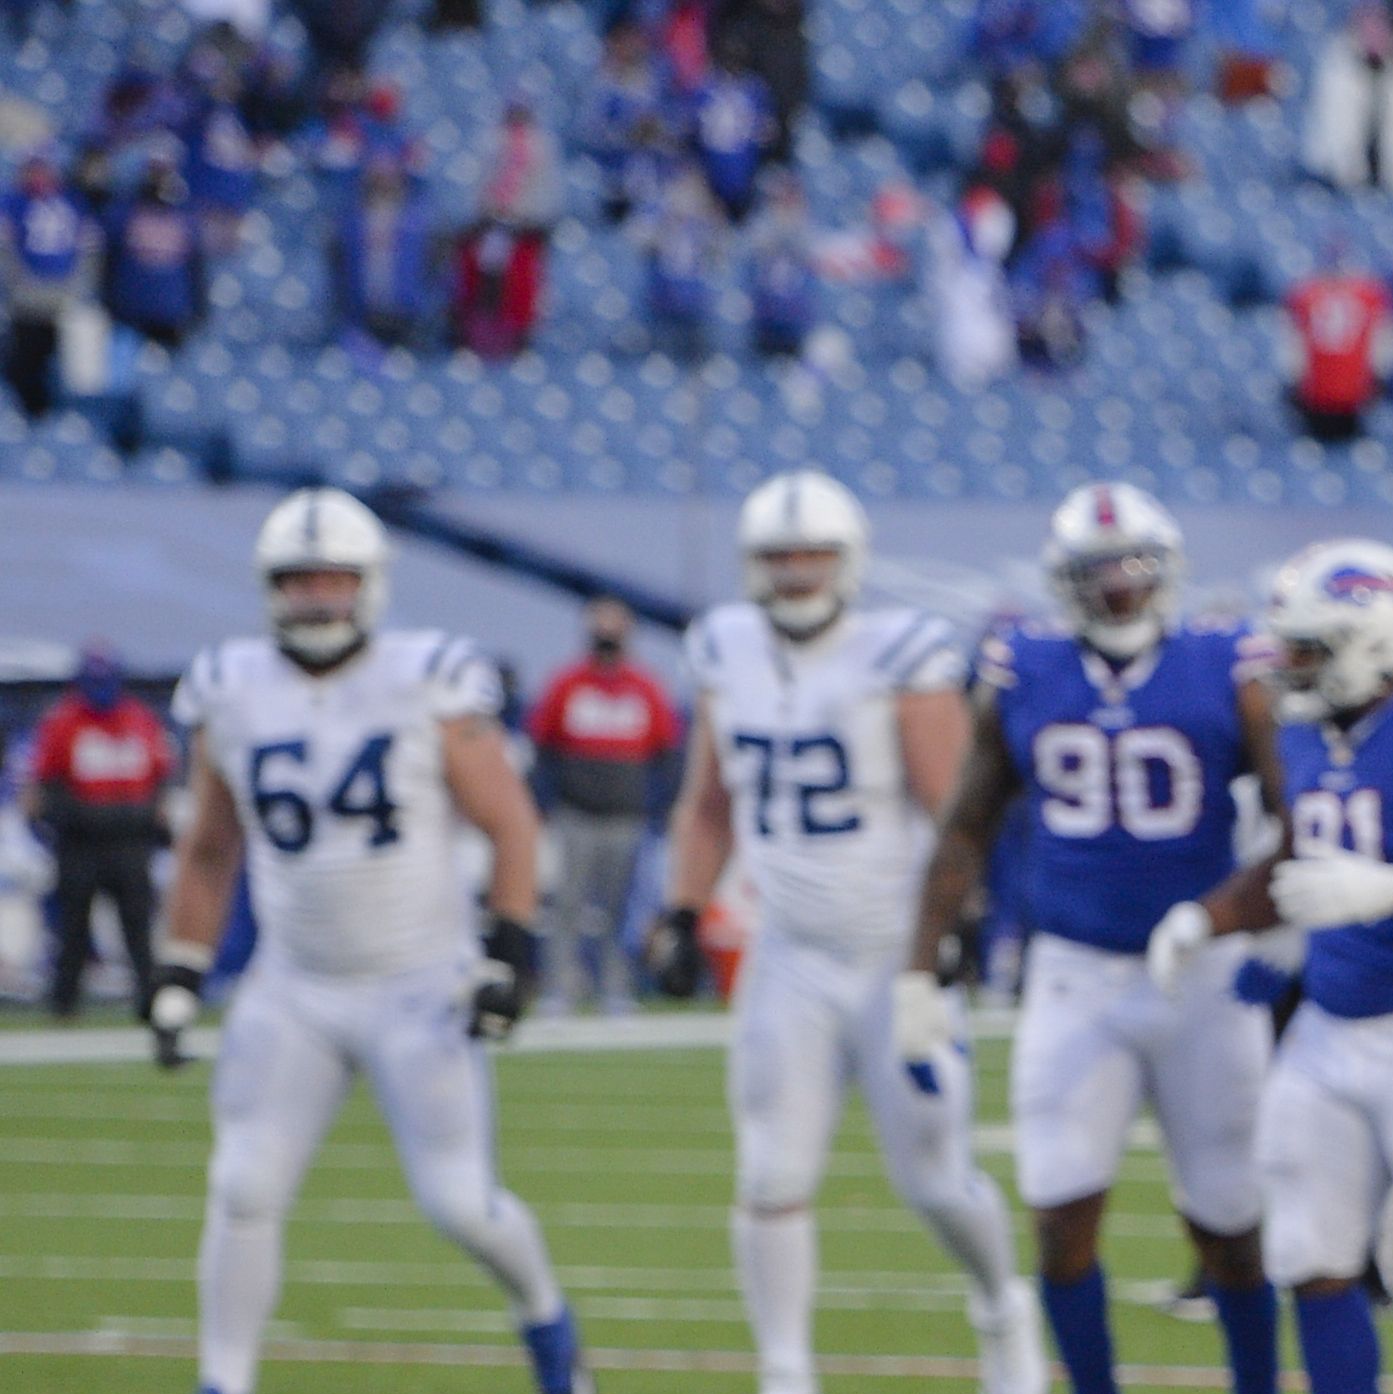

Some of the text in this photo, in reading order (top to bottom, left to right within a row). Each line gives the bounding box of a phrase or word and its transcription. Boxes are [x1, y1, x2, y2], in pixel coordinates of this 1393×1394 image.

[250, 734, 399, 854] 64
[733, 734, 861, 837] 72
[1033, 721, 1204, 842] 90
